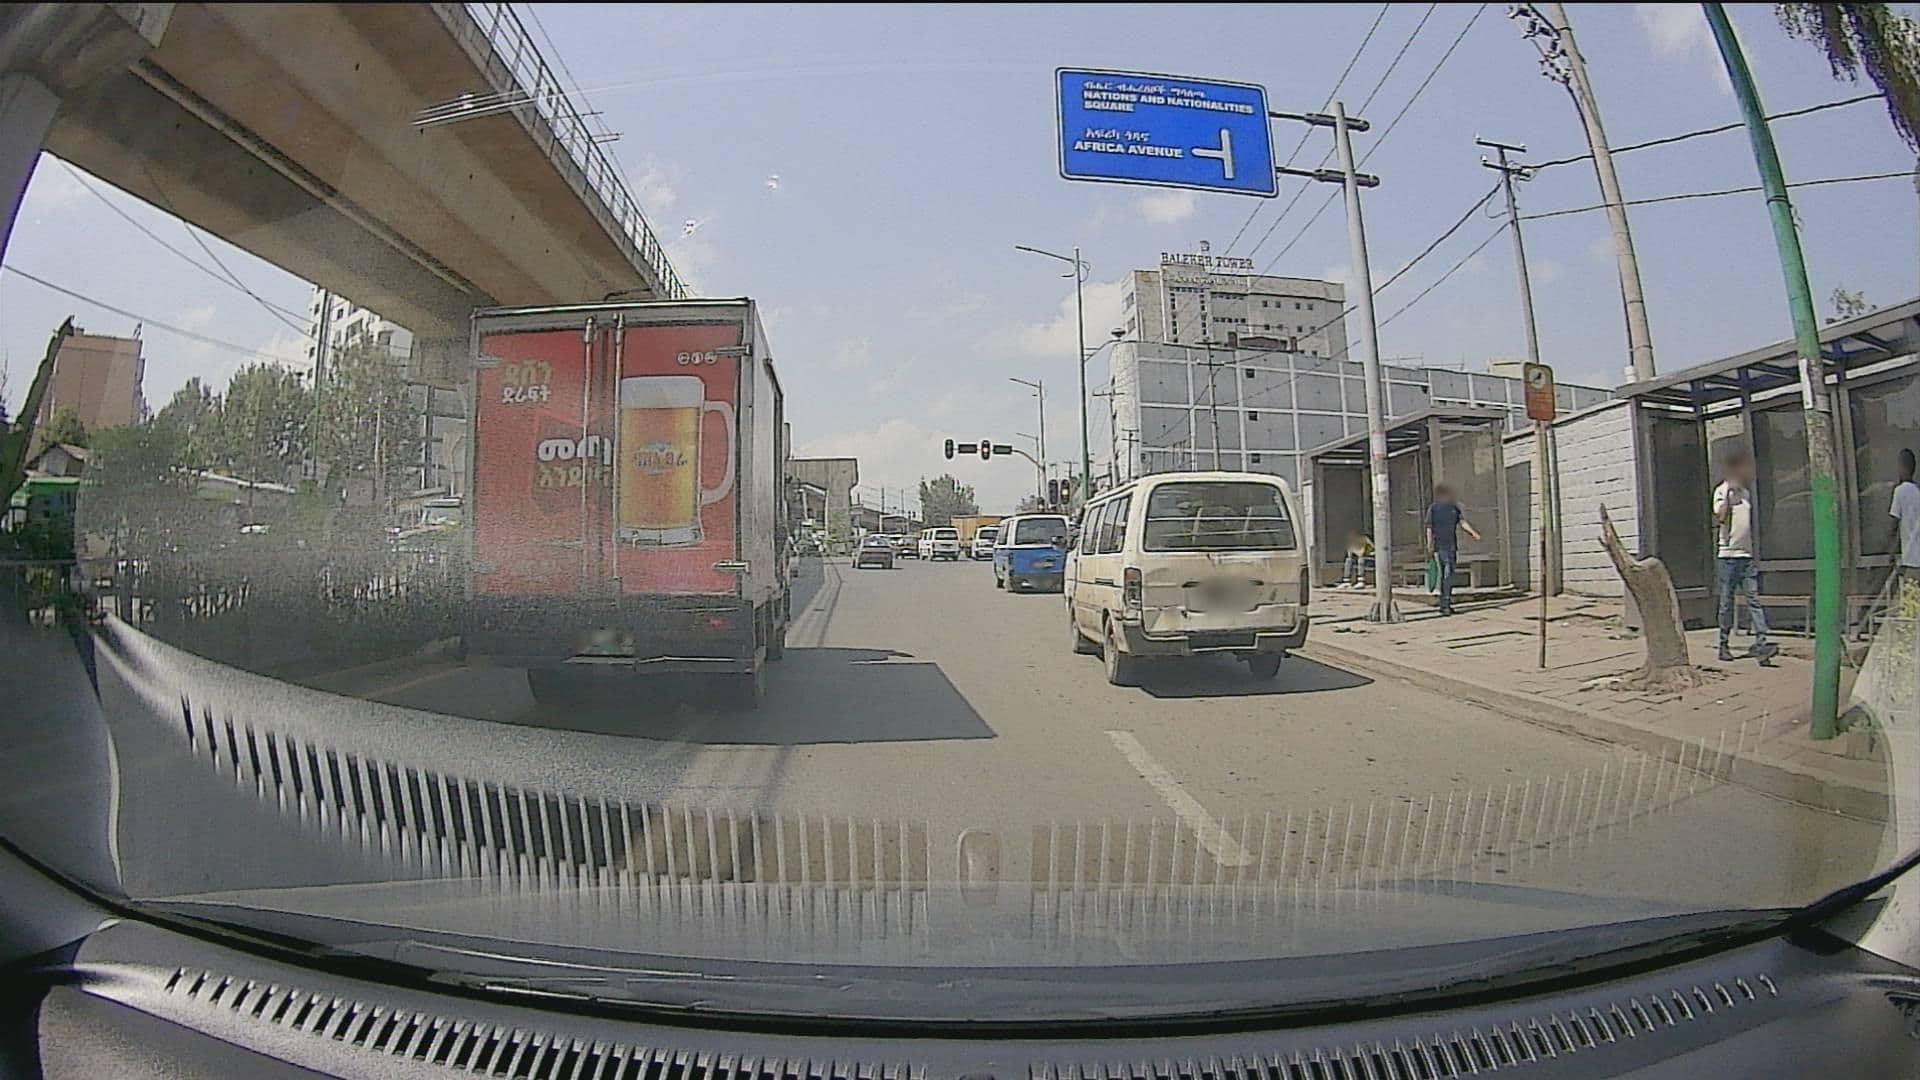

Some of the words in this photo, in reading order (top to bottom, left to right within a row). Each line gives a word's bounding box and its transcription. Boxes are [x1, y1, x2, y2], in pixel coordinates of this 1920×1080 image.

[1083, 91, 1138, 103] NATIONS
[1140, 95, 1165, 105] AND
[1167, 98, 1254, 114] NATIONALITIES
[1083, 102, 1135, 112] SQUARE
[1074, 141, 1126, 153] AFRICA
[1127, 145, 1184, 158] AVENUE
[1215, 256, 1254, 269] TOWER
